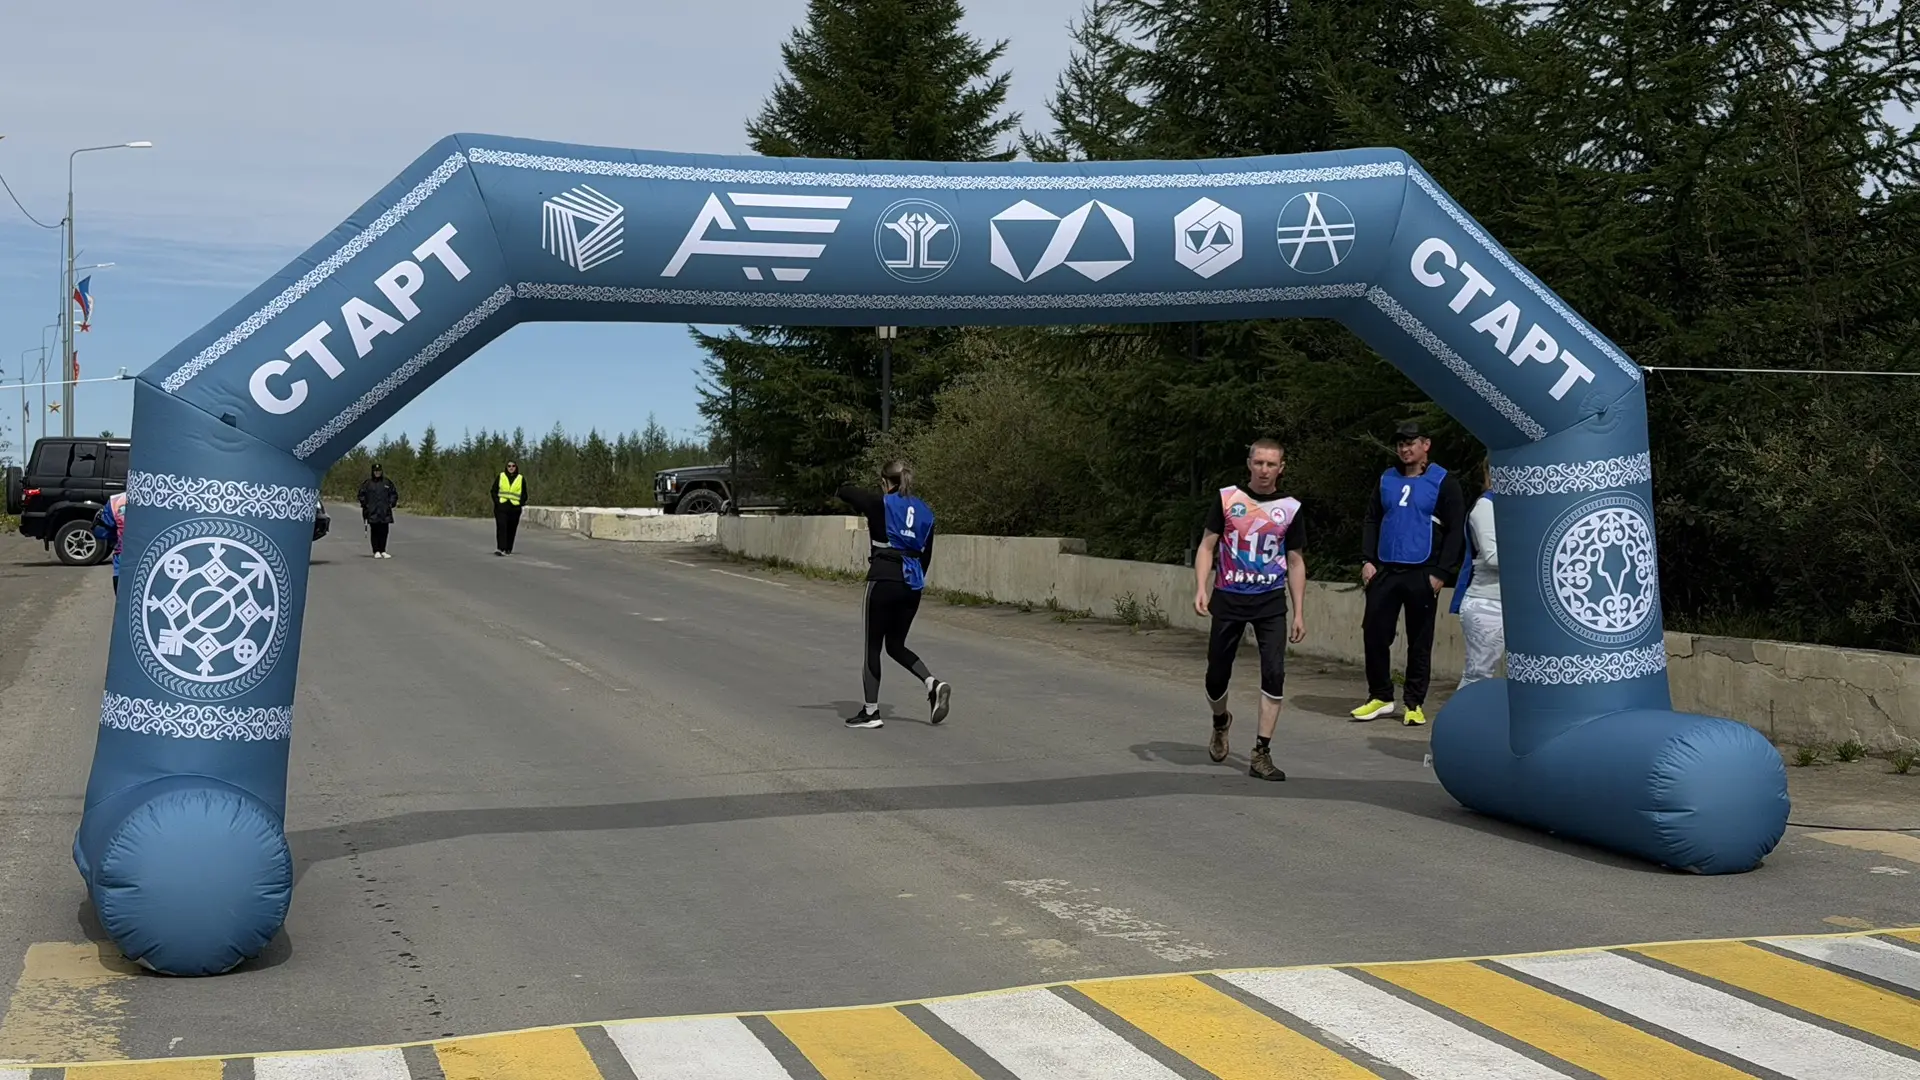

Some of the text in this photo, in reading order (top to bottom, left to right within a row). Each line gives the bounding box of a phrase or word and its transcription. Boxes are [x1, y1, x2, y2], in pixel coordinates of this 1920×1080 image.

[249, 222, 471, 414] СТАРТ
[1410, 237, 1595, 401] СТАРТ
[1398, 484, 1411, 507] 2
[905, 505, 915, 528] 6
[1228, 530, 1279, 564] 115
[1225, 569, 1278, 585] АЙХАЛ
